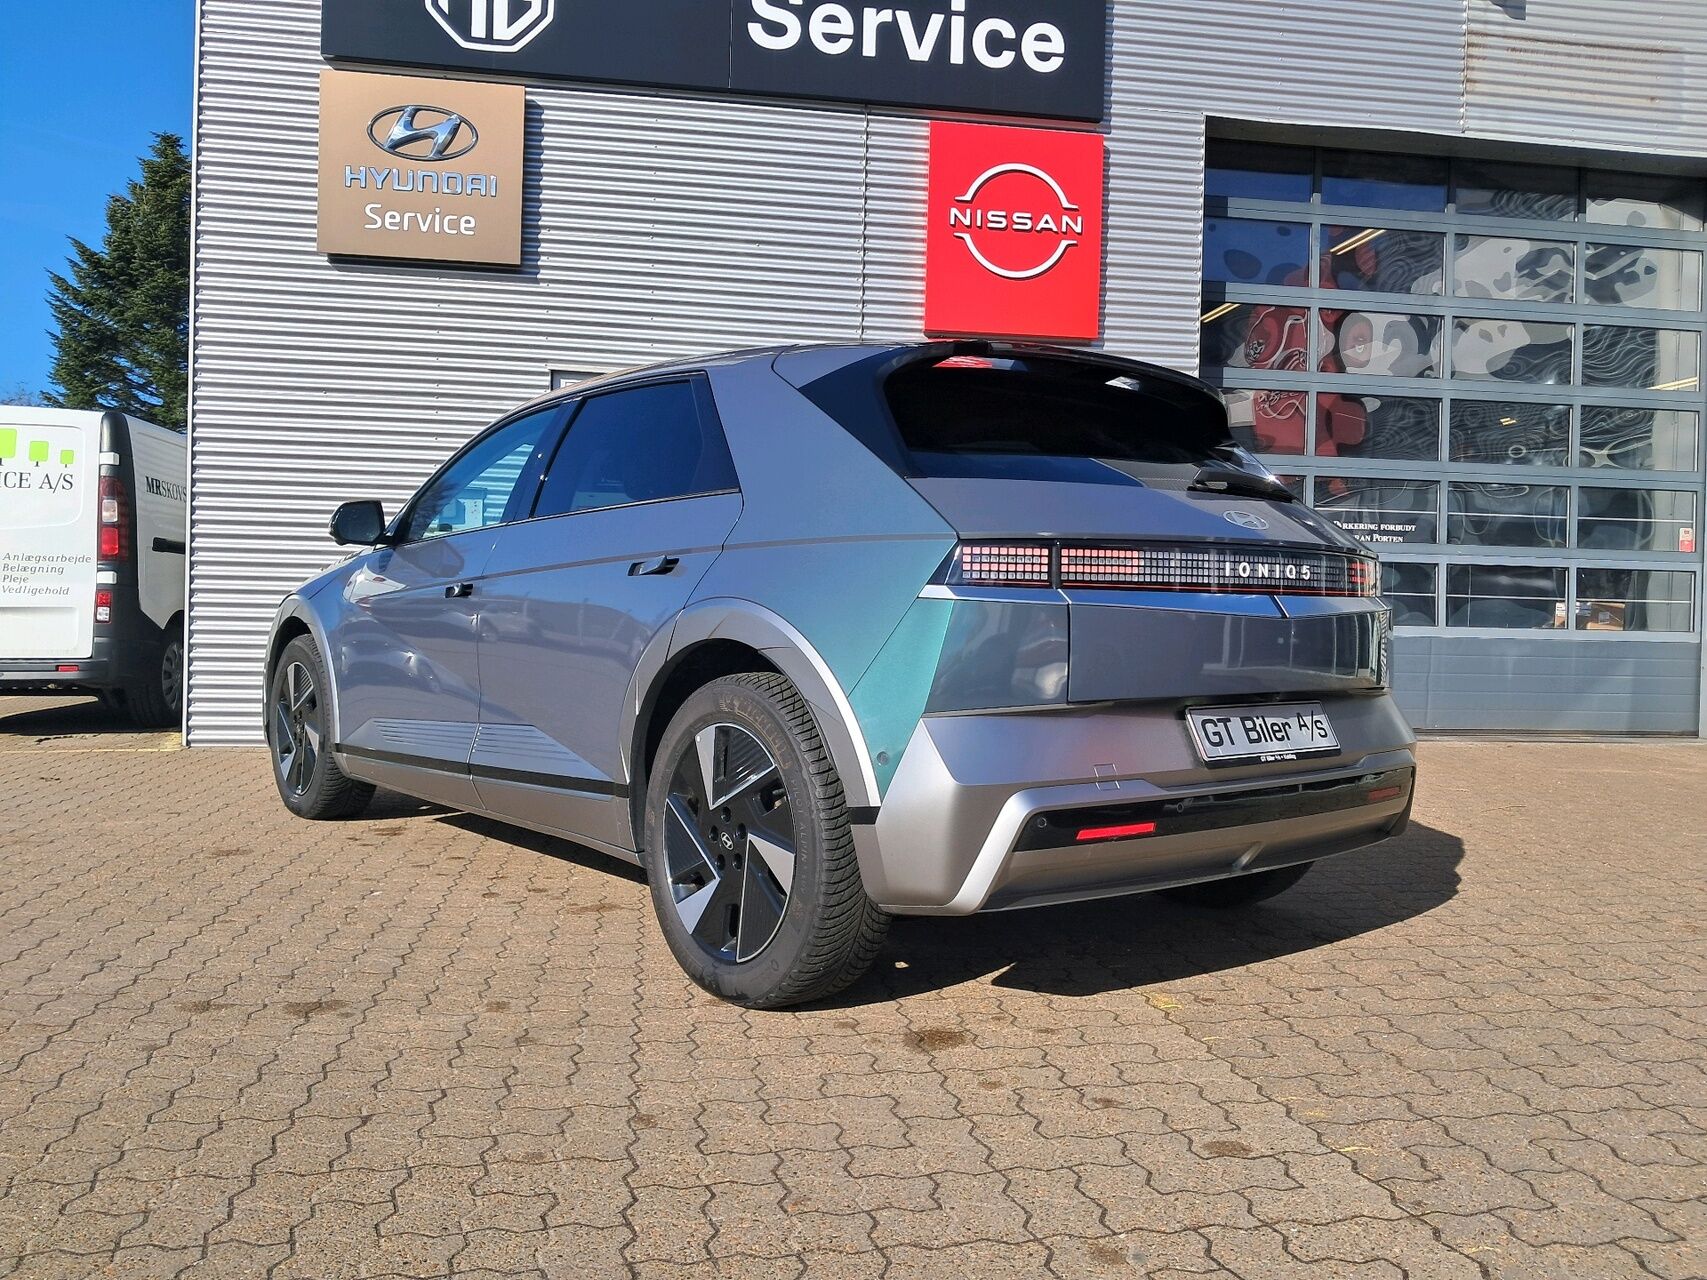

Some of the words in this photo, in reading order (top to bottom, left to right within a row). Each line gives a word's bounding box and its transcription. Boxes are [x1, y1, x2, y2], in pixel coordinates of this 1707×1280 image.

[747, 0, 1066, 73] Service
[344, 165, 497, 197] HYUNDAI
[364, 203, 476, 235] Service
[949, 207, 1083, 235] NISSAN
[38, 472, 74, 494] A/S
[1380, 523, 1416, 532] FORBUDT
[2, 553, 92, 565] Anlægsarbejde
[2, 563, 65, 576] Belægning
[2, 574, 29, 584] Pleje
[2, 585, 70, 597] Vedligehold
[1201, 717, 1235, 747] GT
[1239, 715, 1292, 744] Biler
